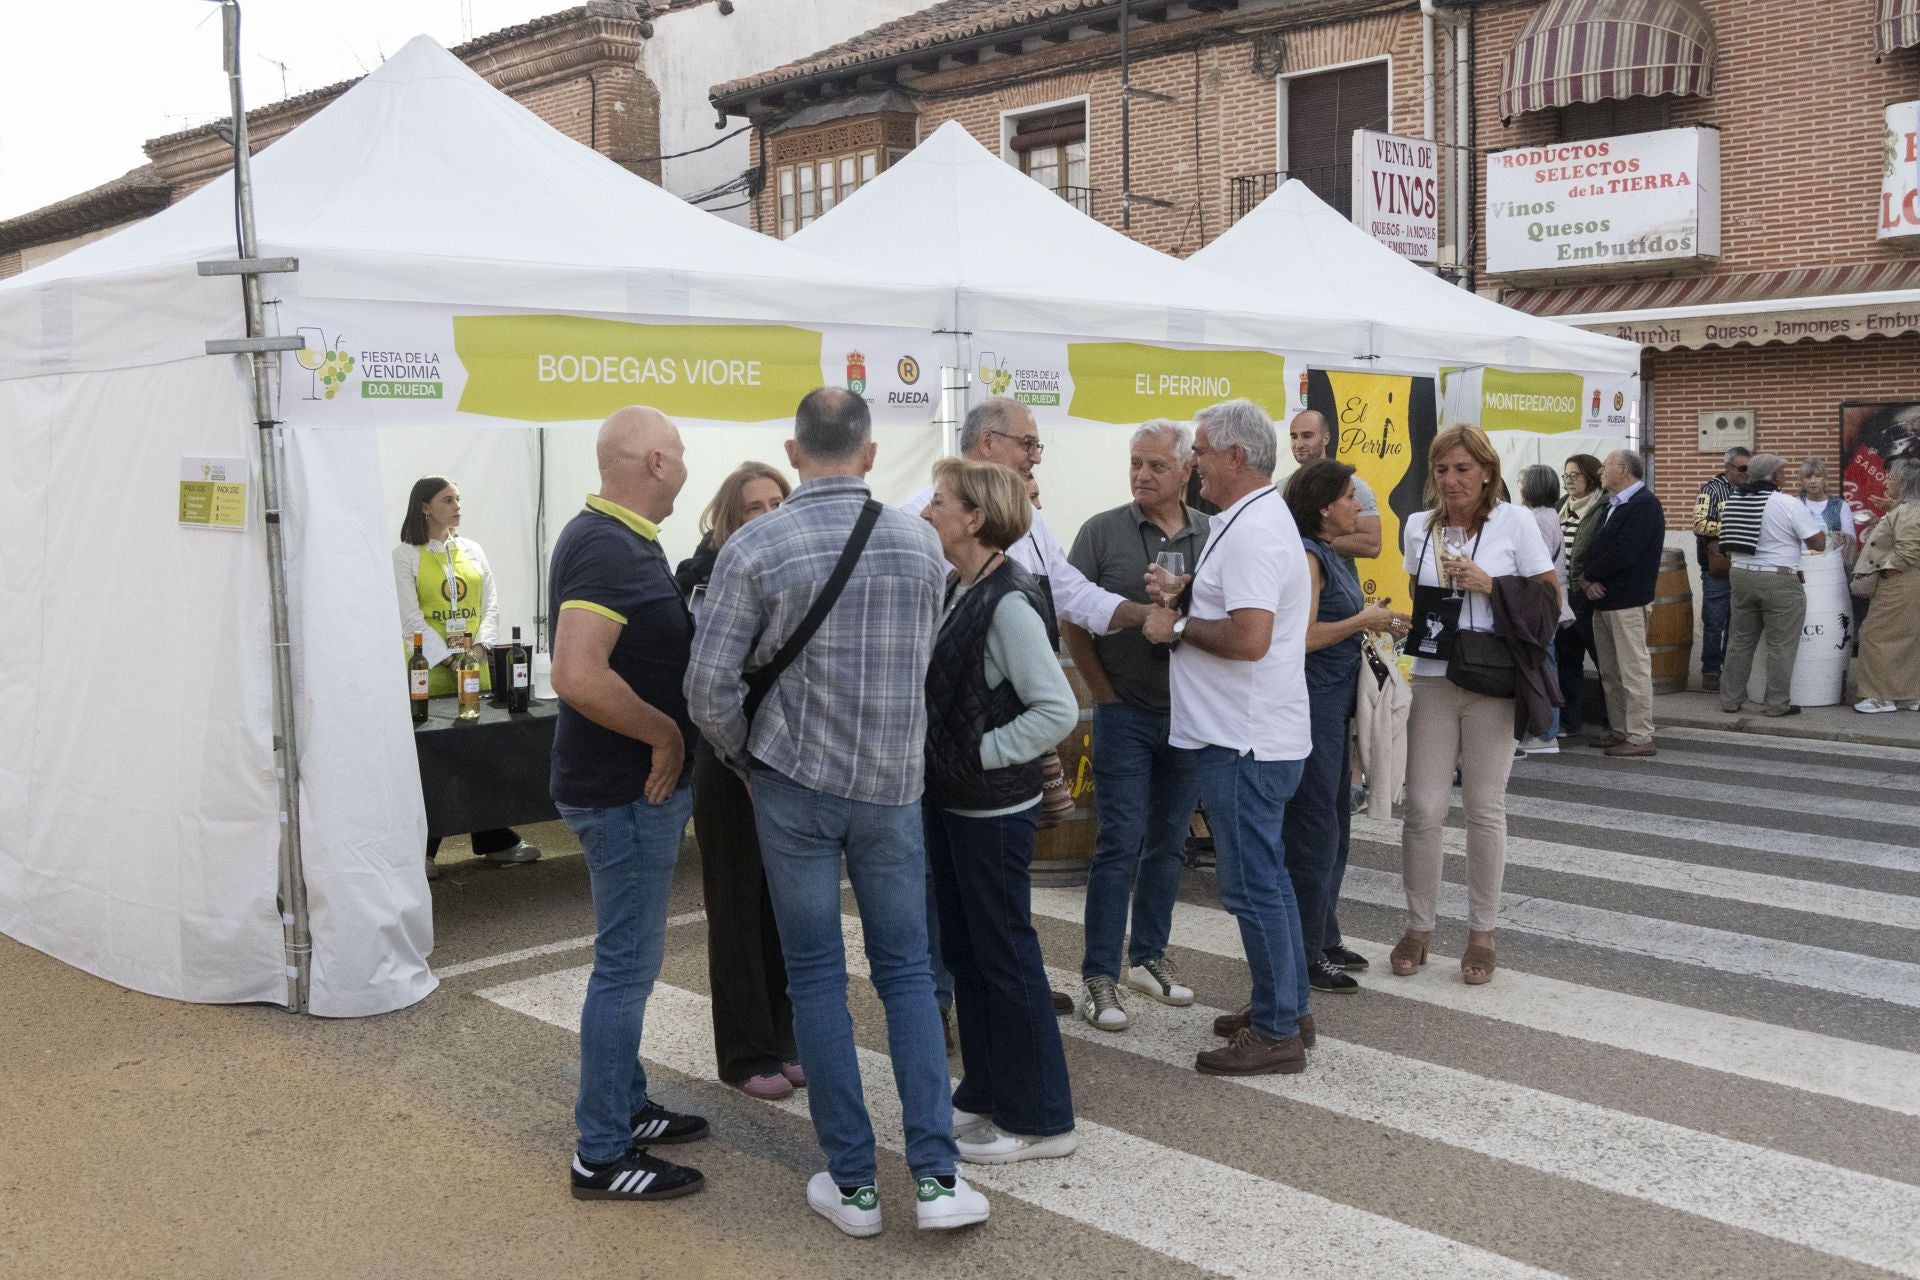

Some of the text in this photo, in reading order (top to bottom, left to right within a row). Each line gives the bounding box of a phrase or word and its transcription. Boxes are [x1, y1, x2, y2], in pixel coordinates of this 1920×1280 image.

[1376, 139, 1432, 169] VENTA DE
[1535, 158, 1640, 183] SELECTOS
[1371, 170, 1435, 219] VINOS
[1568, 171, 1691, 198] de la TIERRA
[1491, 200, 1556, 219] Vinos
[1371, 221, 1400, 237] QUESOS
[1527, 219, 1610, 242] Quesos
[1556, 235, 1692, 261] Embutidos
[1705, 324, 1758, 341] Queso
[1773, 319, 1850, 336] Jamones
[1867, 312, 1920, 329] Embu
[361, 351, 440, 364] FIESTA DE LA
[361, 364, 440, 379] VENDIMIA
[538, 353, 761, 386] BODEGAS VIORE
[1015, 369, 1060, 380] FIESTA DE LA
[368, 383, 436, 396] D.O. RUEDA
[1014, 379, 1060, 391] VENDIMIA
[1135, 373, 1231, 397] EL PERRINO
[888, 391, 929, 404] RUEDA
[1031, 394, 1057, 404] RUEDA
[1486, 392, 1576, 413] MONTEPEDROSO
[1341, 396, 1368, 424] El
[1607, 416, 1626, 424] RUEDA
[1855, 454, 1885, 480] SABO
[1803, 625, 1824, 636] CE
